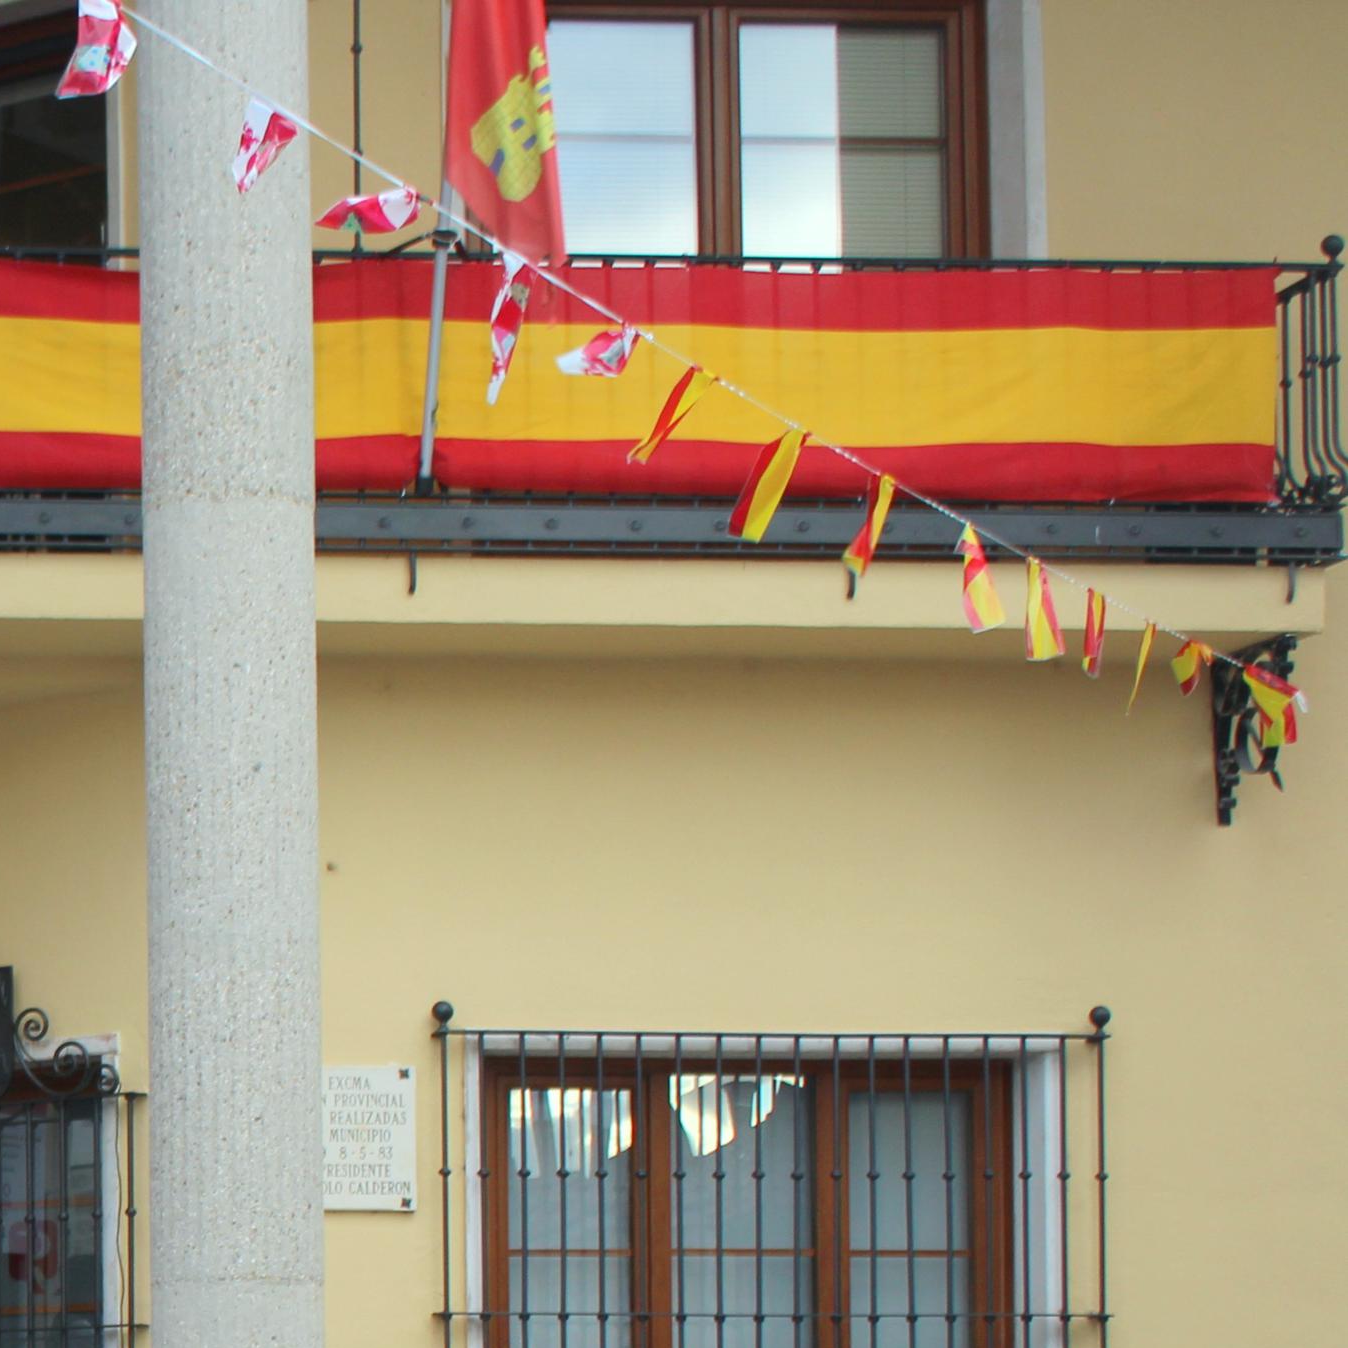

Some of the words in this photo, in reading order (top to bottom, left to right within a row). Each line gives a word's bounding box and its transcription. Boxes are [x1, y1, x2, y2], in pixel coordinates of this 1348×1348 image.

[328, 1076, 370, 1091] EXCMA
[333, 1093, 407, 1108] PROVINCIAL
[329, 1111, 407, 1125] REALIZADAS
[329, 1128, 392, 1143] MUNICIPIO
[348, 1181, 411, 1195] CALDERON
